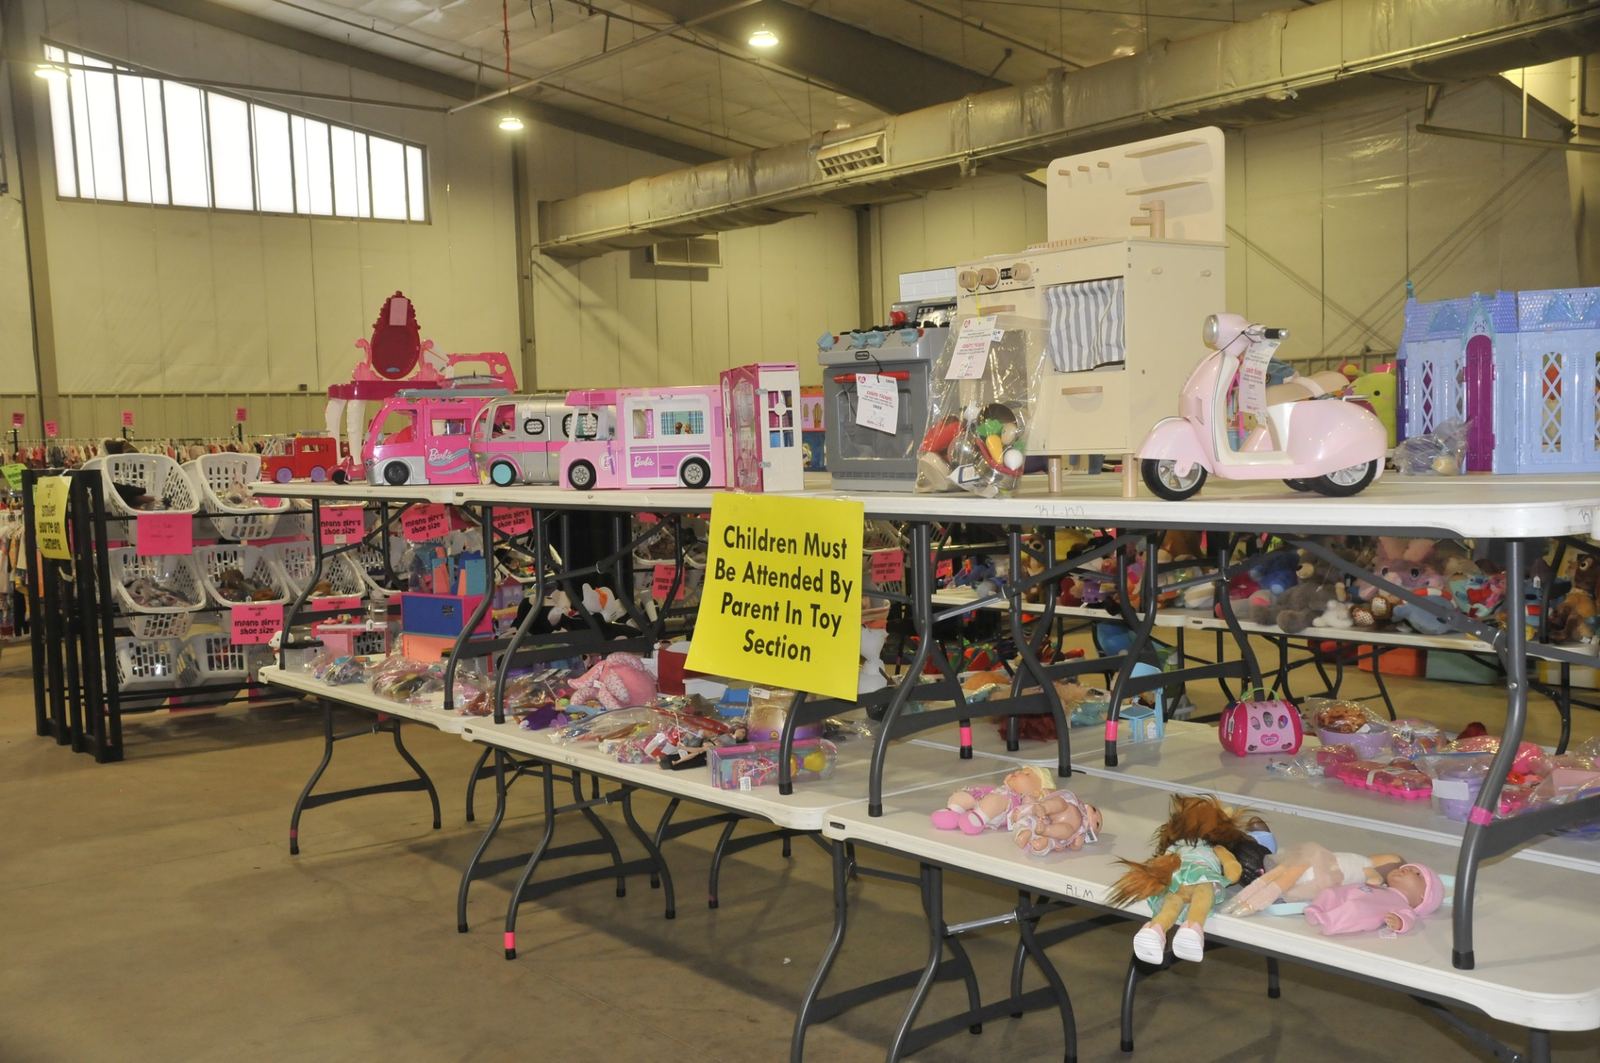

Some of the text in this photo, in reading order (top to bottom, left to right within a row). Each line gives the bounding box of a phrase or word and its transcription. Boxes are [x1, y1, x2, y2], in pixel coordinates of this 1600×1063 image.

[428, 449, 455, 463] Barbie
[633, 455, 656, 468] Barbie
[723, 526, 848, 560] Children Must
[715, 558, 853, 603] Be Attended By
[240, 626, 274, 635] shoe size
[721, 592, 842, 637] Parent In Toy
[743, 629, 811, 662] Section
